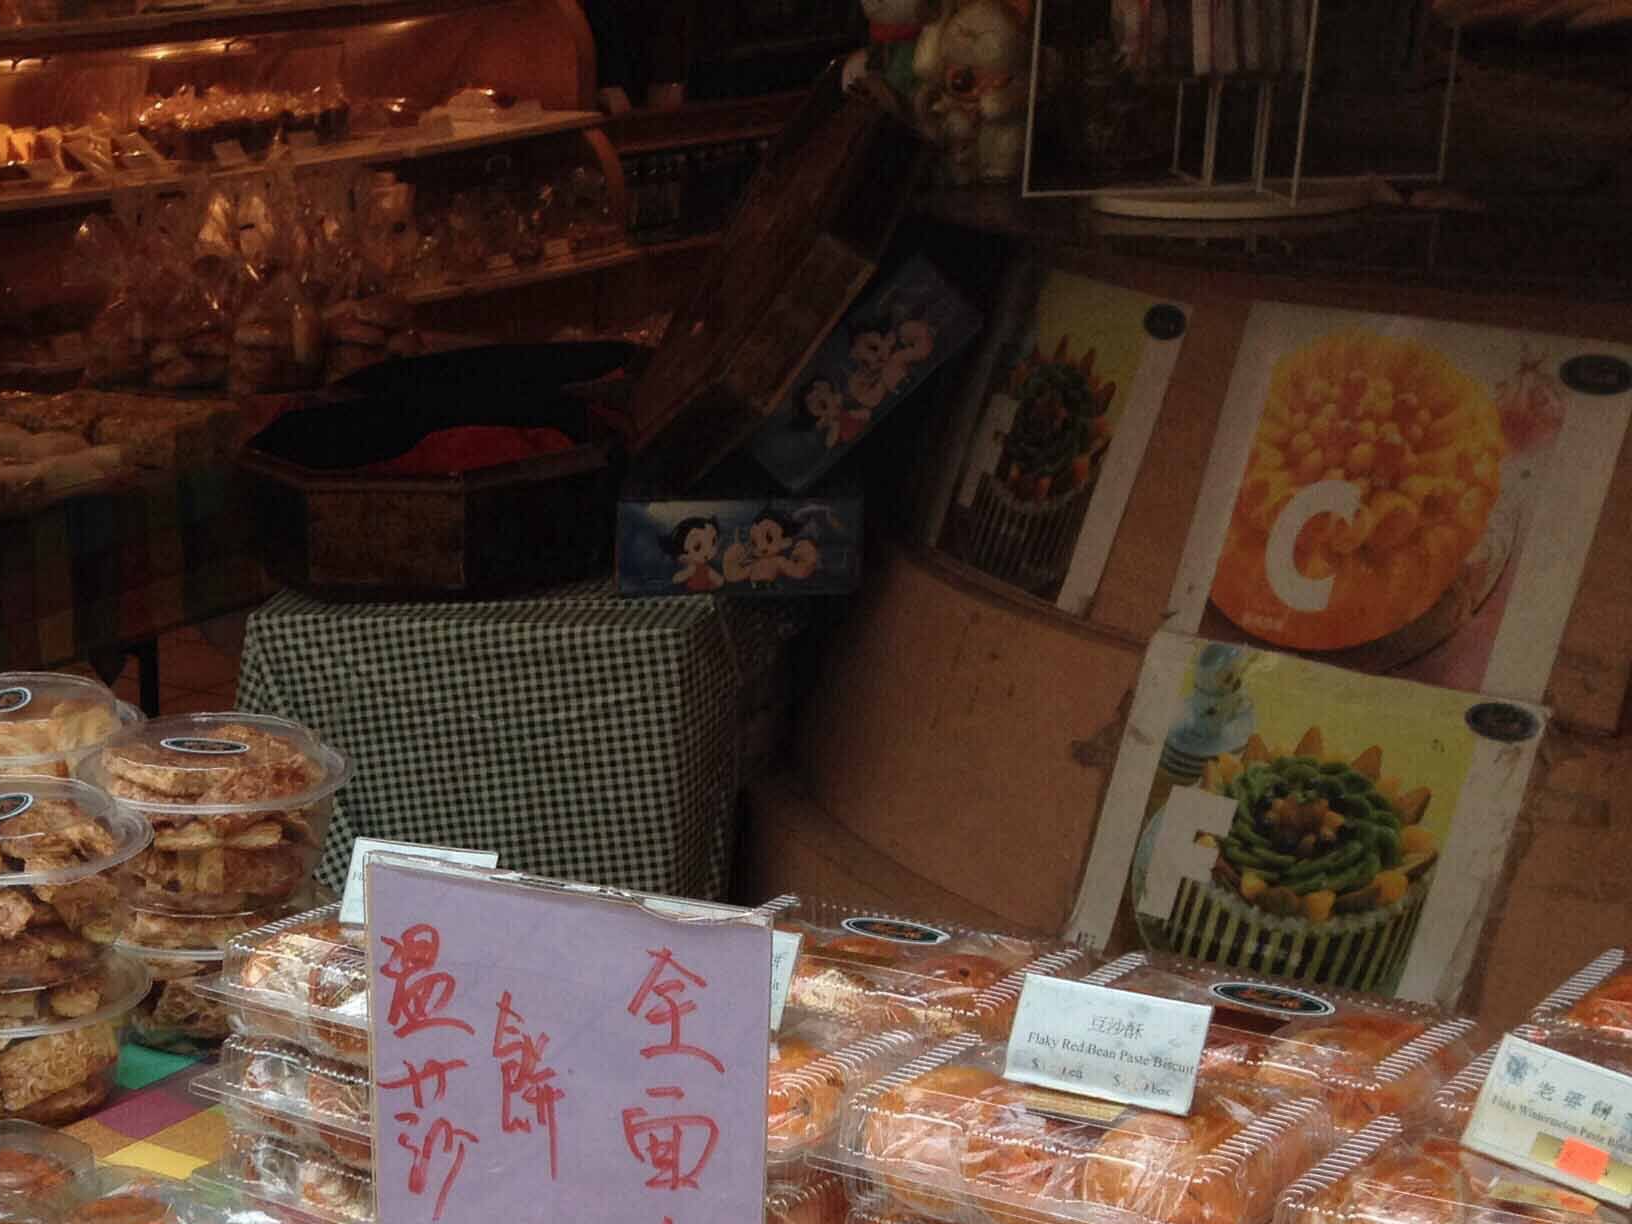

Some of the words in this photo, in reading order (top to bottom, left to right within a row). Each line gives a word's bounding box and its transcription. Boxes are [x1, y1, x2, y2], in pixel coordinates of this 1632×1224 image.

[1265, 479, 1363, 613] C
[1027, 1031, 1057, 1049] Flaky
[1062, 1037, 1084, 1054] Red
[1088, 1043, 1116, 1060] Bean
[1120, 1049, 1151, 1066] Paste
[1153, 1055, 1194, 1075] Biscuit
